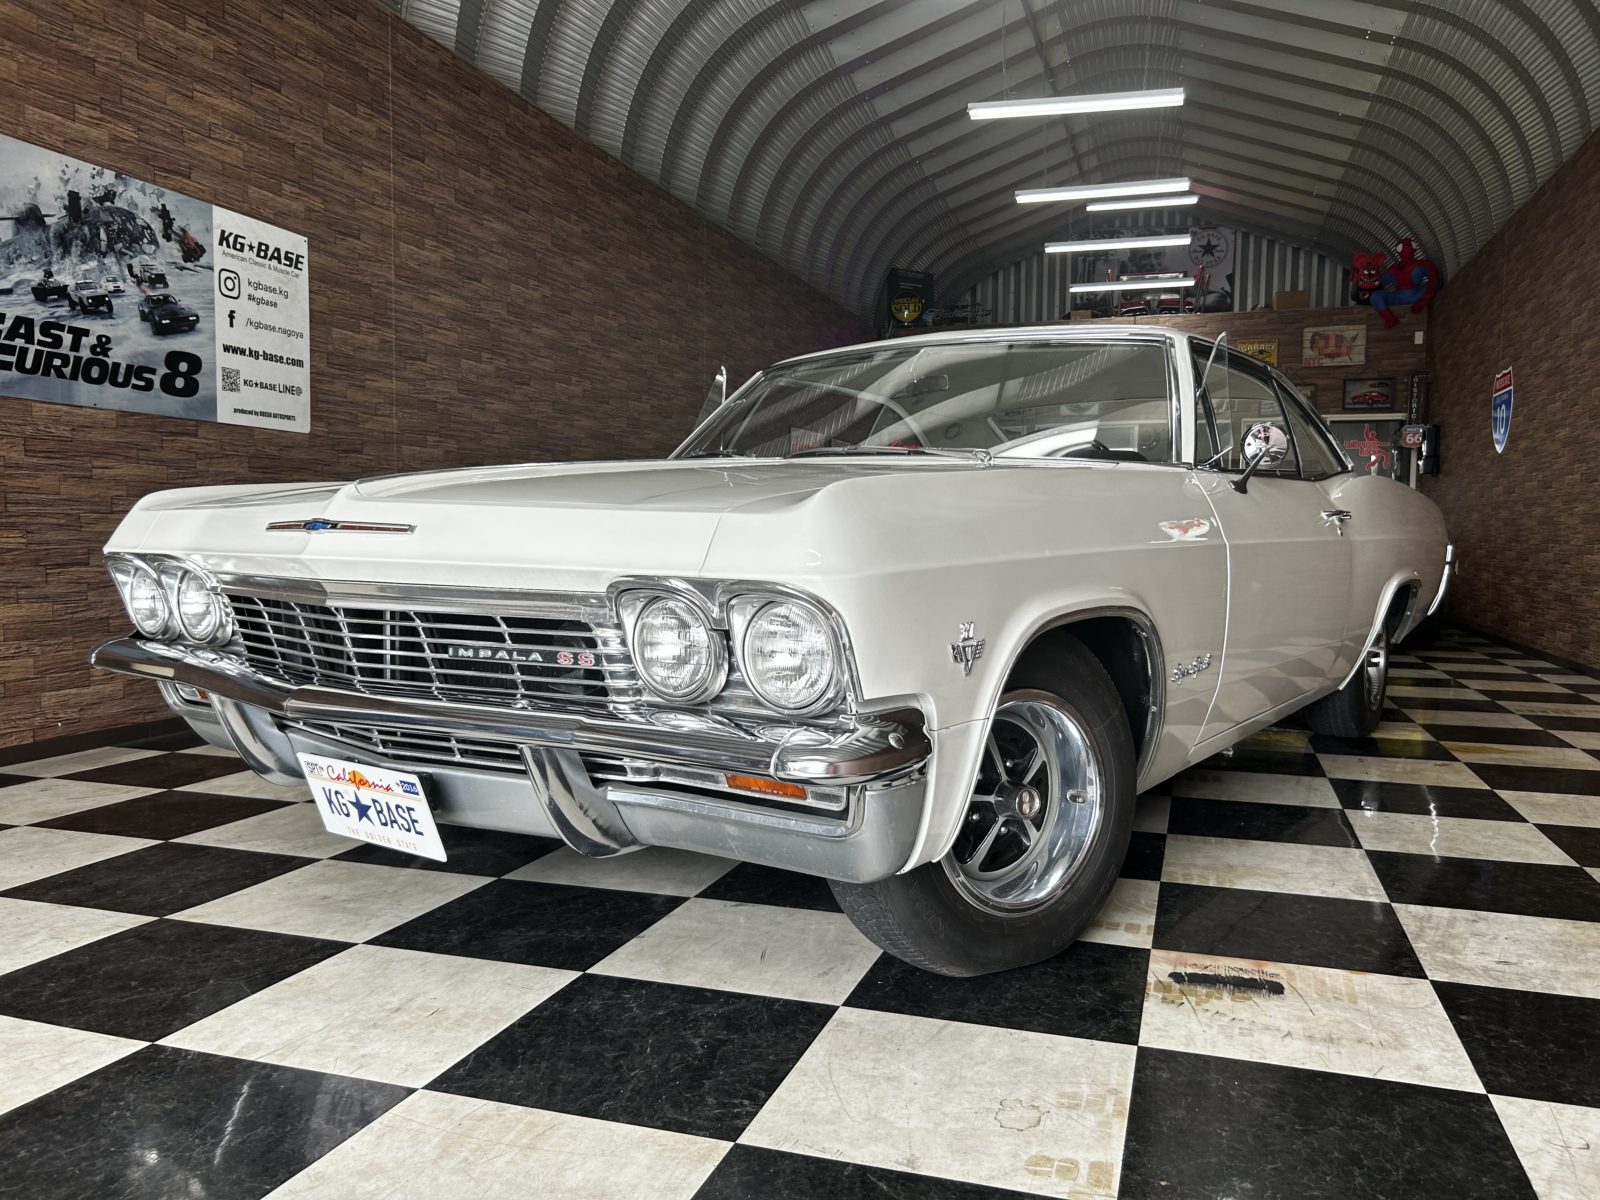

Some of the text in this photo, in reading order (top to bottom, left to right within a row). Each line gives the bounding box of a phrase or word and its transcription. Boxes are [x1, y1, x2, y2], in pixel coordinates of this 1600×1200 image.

[218, 229, 304, 271] KG BASE
[222, 250, 300, 279] American Classic & Muscle Car
[247, 278, 289, 299] kgbase.kg
[247, 294, 278, 309] #kgbase
[894, 304, 920, 313] SOLD
[0, 312, 113, 358] AST &
[245, 318, 304, 339] /kgbase.nagoya
[222, 343, 304, 368] www.kg-base.com
[159, 350, 203, 398] 8
[243, 379, 303, 397] KG BASE LINE@
[233, 407, 253, 416] produced
[1496, 404, 1506, 435] 10
[1406, 433, 1422, 444] 66
[448, 647, 595, 667] IMPALA SS
[326, 764, 394, 791] California
[322, 787, 424, 836] KG BASE
[347, 827, 416, 852] THE GOLDEN STATE
